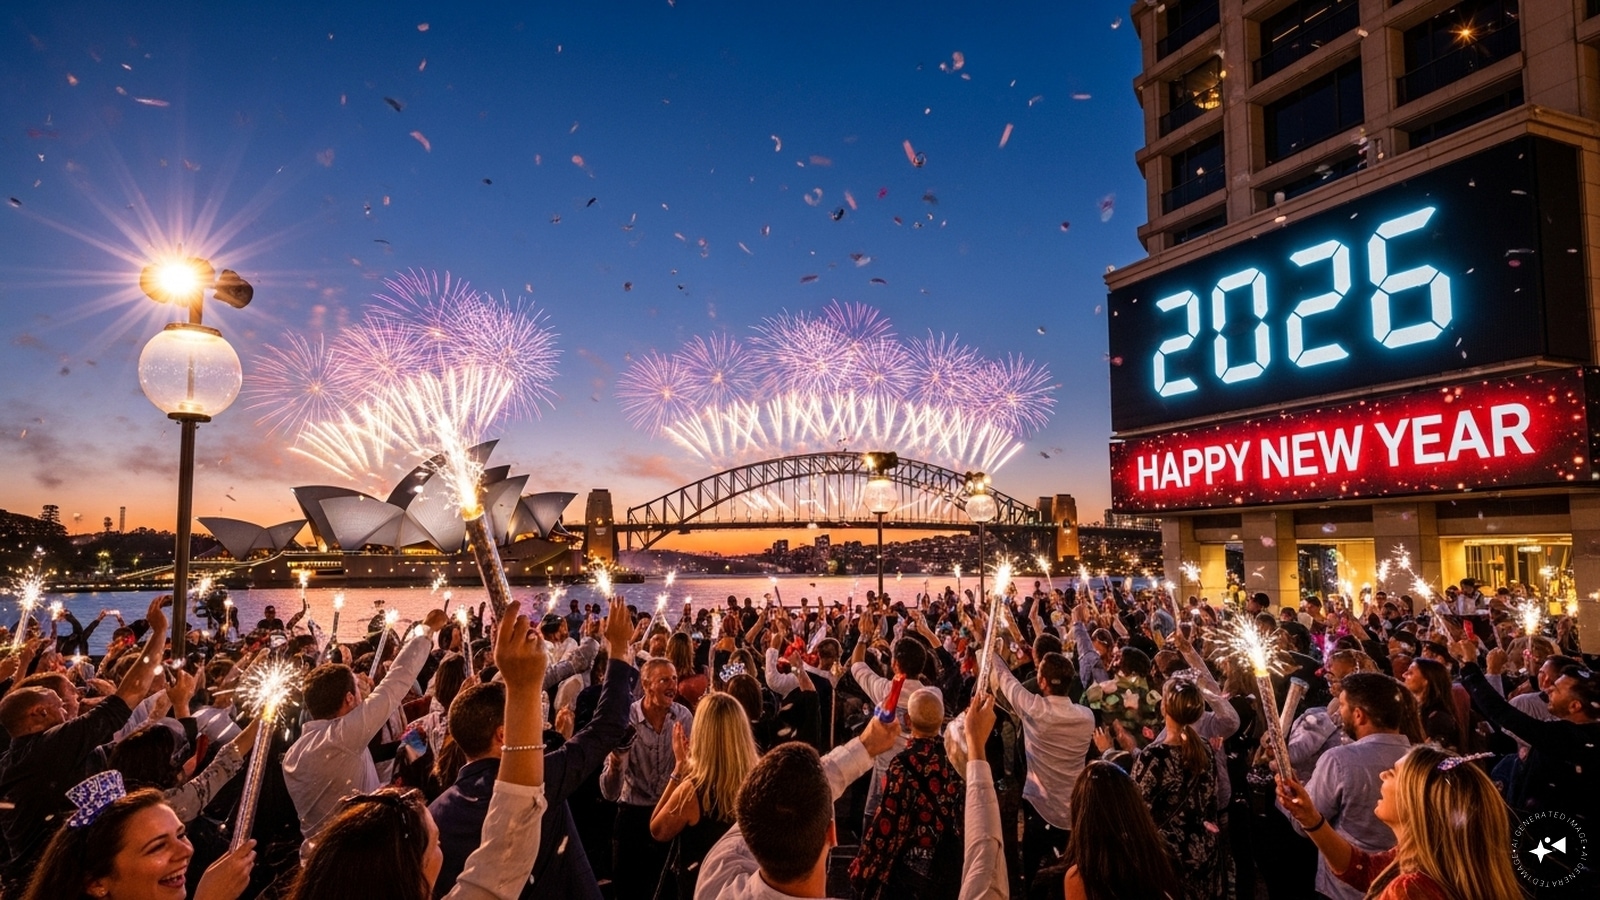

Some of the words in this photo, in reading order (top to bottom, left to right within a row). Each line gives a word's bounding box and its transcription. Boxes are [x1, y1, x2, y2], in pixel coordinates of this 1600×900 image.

[1153, 206, 1453, 397] 2026
[1137, 441, 1250, 491] HAPPY
[1260, 424, 1363, 479] NEW
[1374, 403, 1535, 467] YEAR
